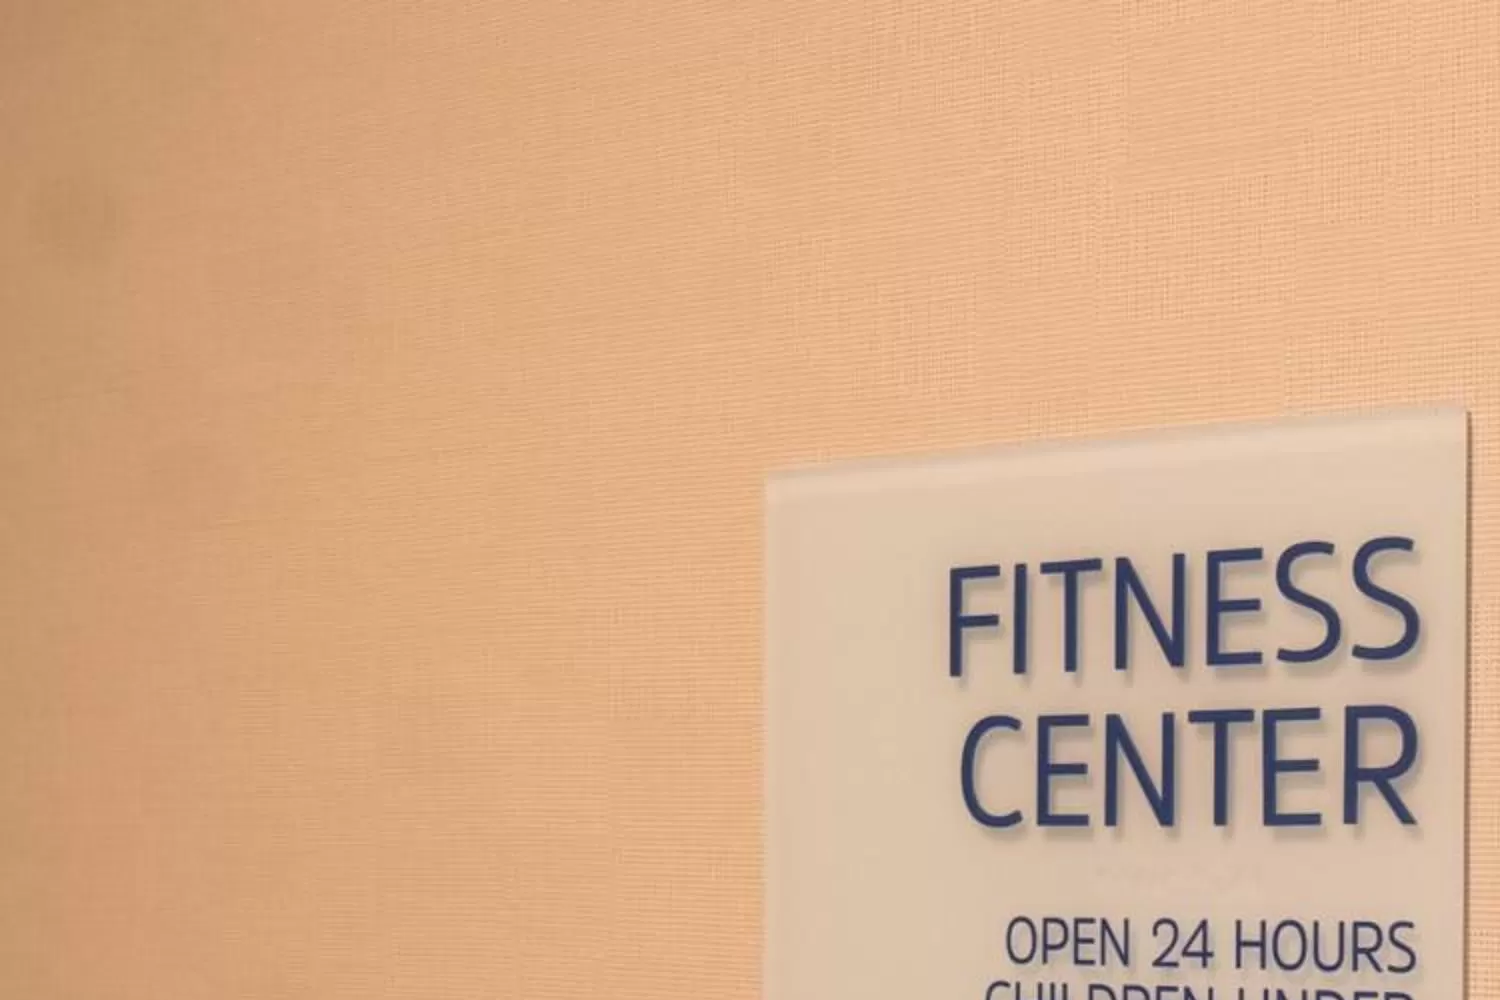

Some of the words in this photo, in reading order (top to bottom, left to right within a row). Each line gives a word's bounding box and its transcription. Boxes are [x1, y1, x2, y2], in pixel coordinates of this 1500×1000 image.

[949, 536, 1421, 678] FITNESS
[960, 704, 1420, 830] CENTER
[1005, 915, 1131, 968] OPEN
[1151, 917, 1215, 969] 24
[1235, 919, 1417, 974] HOURS
